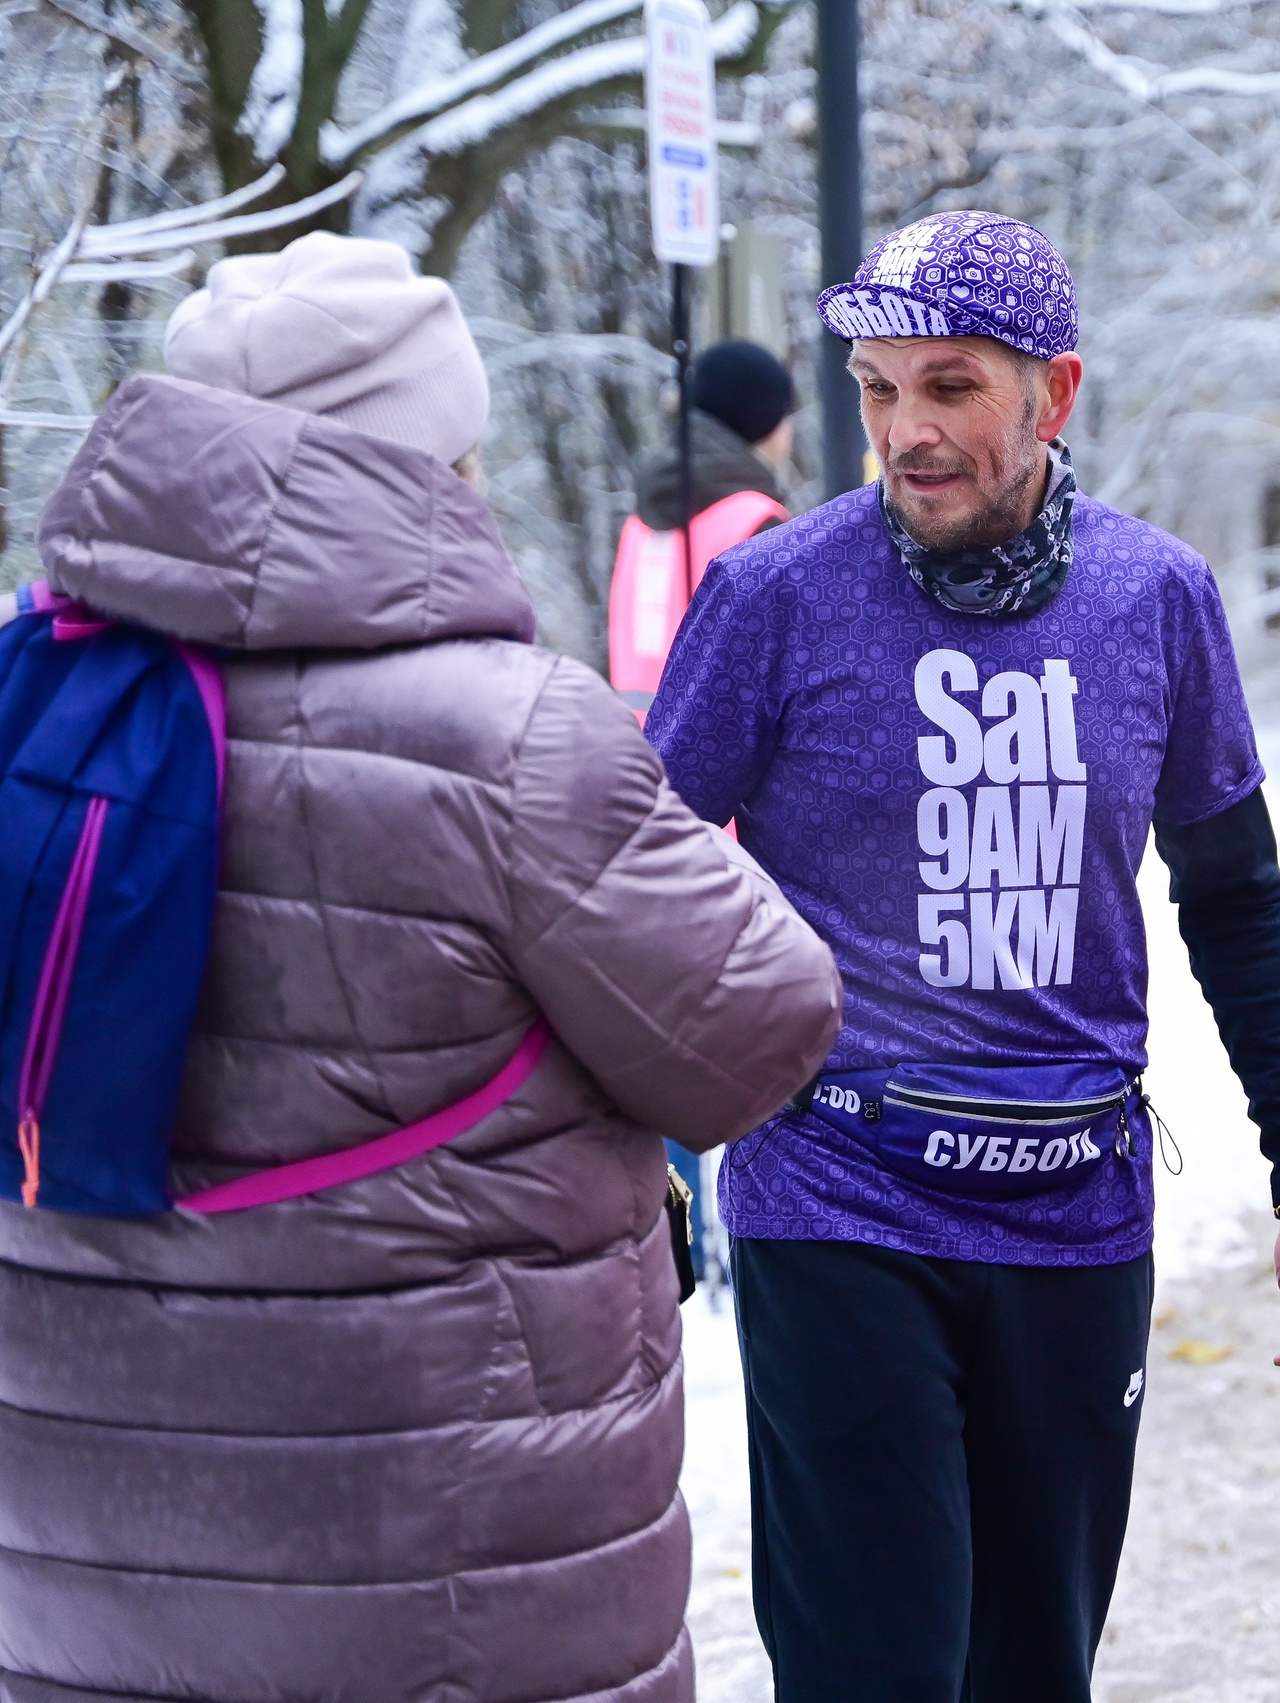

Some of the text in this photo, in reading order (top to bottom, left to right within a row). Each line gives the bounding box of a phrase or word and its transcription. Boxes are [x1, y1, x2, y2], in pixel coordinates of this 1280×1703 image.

[914, 648, 1087, 786] Sat
[916, 784, 1087, 891] 9AM
[917, 887, 1080, 991] 5KM
[923, 1127, 1101, 1173] СУББОТА
